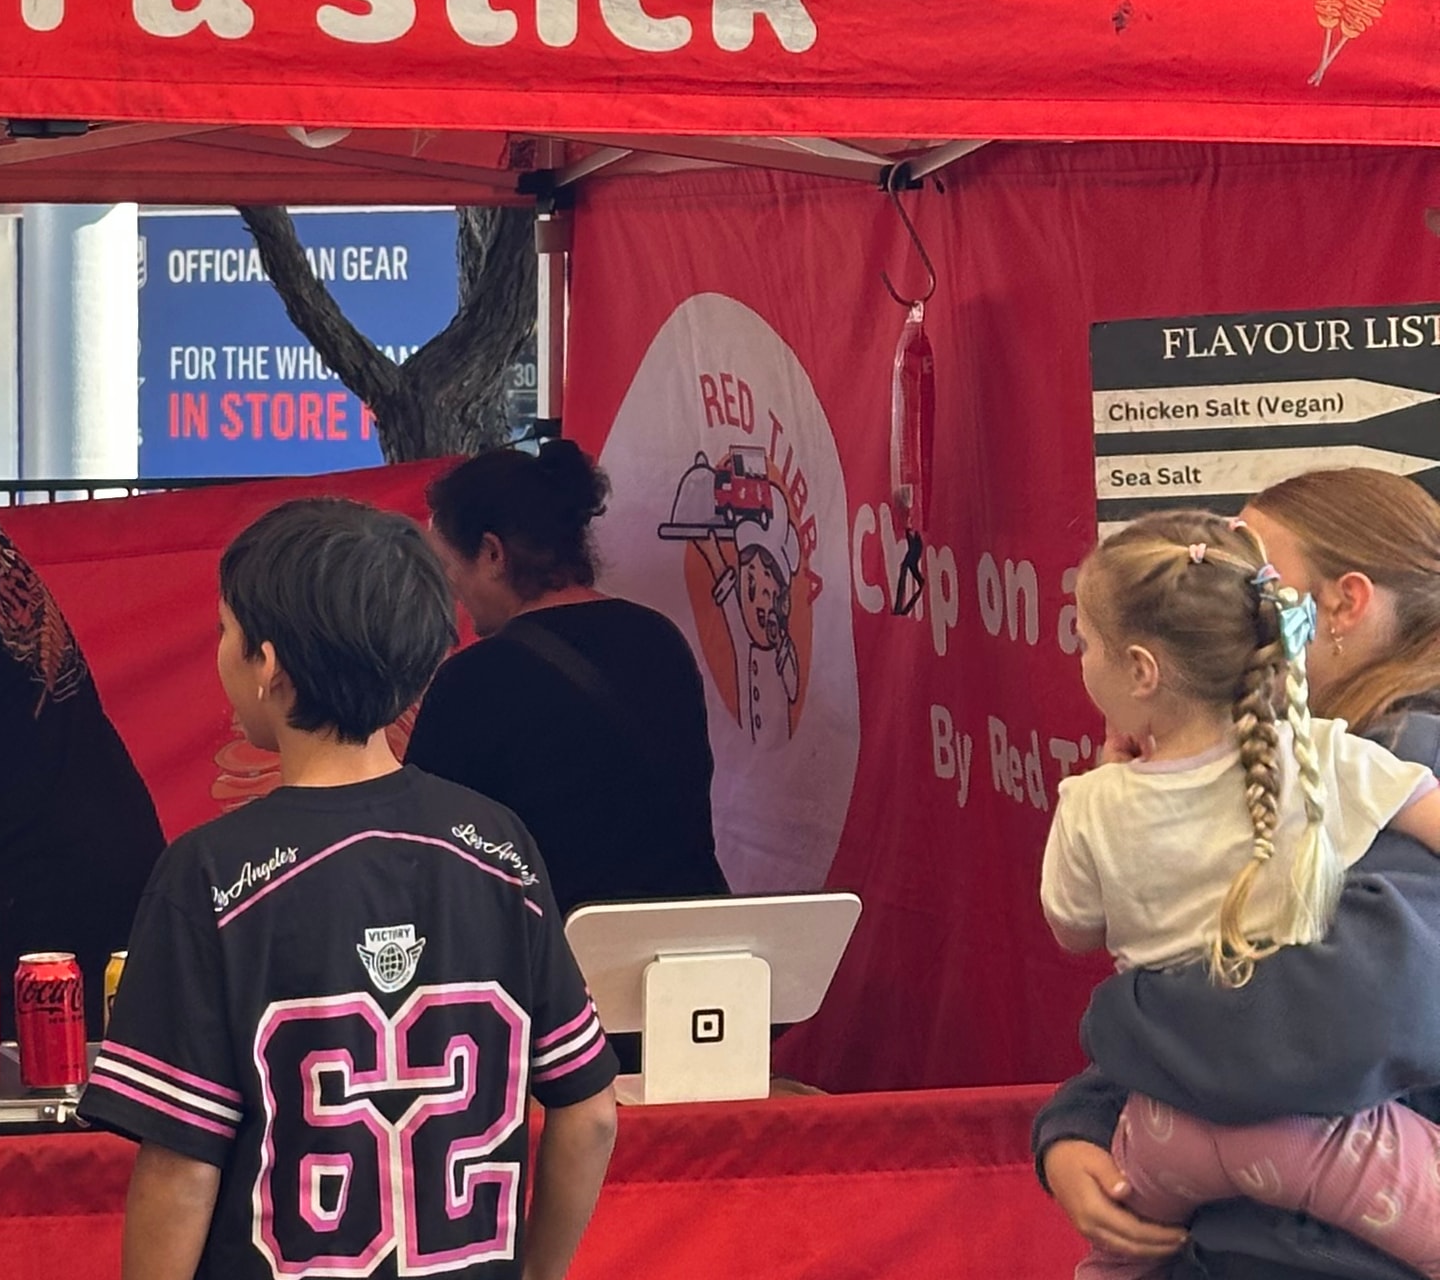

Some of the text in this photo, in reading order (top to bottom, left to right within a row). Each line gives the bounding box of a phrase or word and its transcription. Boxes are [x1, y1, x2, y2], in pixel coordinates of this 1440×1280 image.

[168, 245, 409, 283] OFFICIA AN GEAR
[1162, 319, 1354, 360] FLAVOUR
[170, 345, 216, 381] FOR
[222, 345, 270, 381] THE
[168, 391, 209, 440] IN
[219, 391, 349, 441] STORE
[1108, 392, 1345, 422] Chicken Salt (Vegan)
[700, 372, 825, 607] RED TIBBA
[1110, 465, 1202, 488] Sea Salt
[977, 551, 1040, 646] on
[929, 703, 973, 809] By
[987, 714, 1050, 813] Red
[228, 846, 300, 899] Angeles
